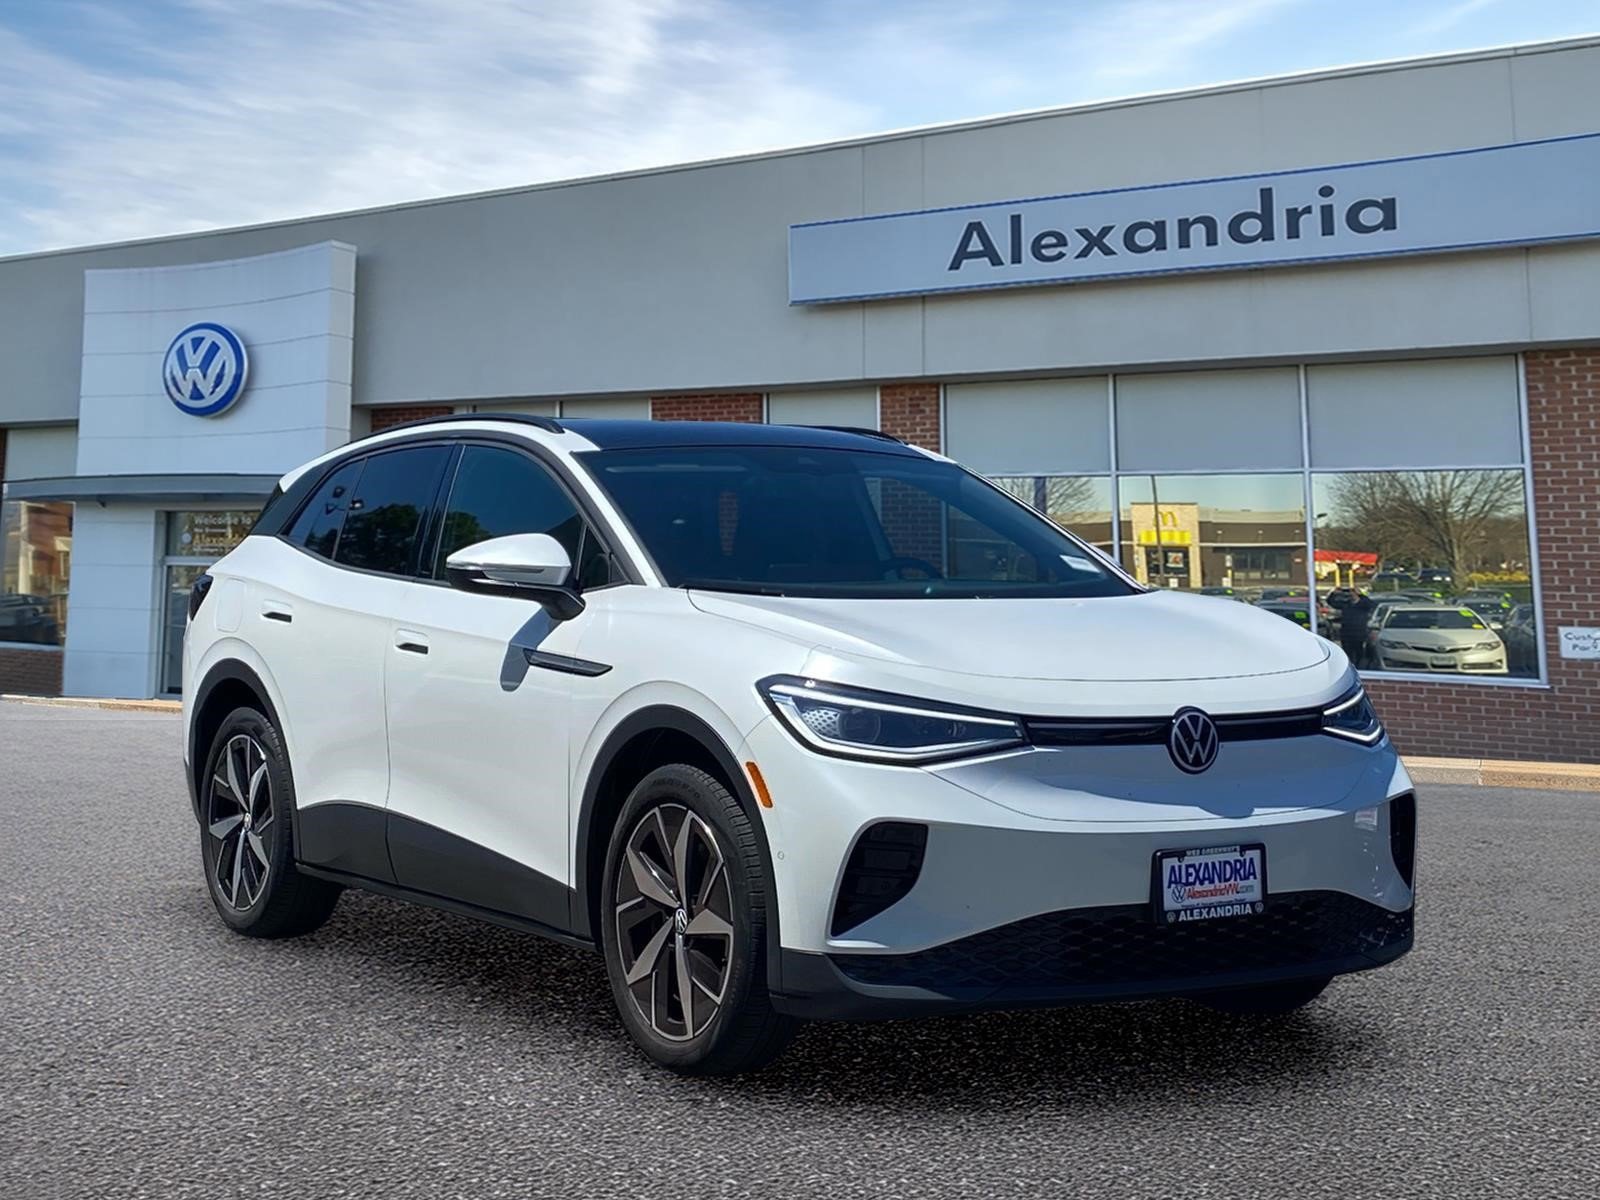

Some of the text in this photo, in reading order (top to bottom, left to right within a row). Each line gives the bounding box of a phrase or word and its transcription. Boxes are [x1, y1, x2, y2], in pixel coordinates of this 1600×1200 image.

[948, 185, 1398, 271] Alexandria
[1167, 857, 1257, 889] ALEXANDRIA
[1178, 904, 1252, 921] ALEXANDRIA
